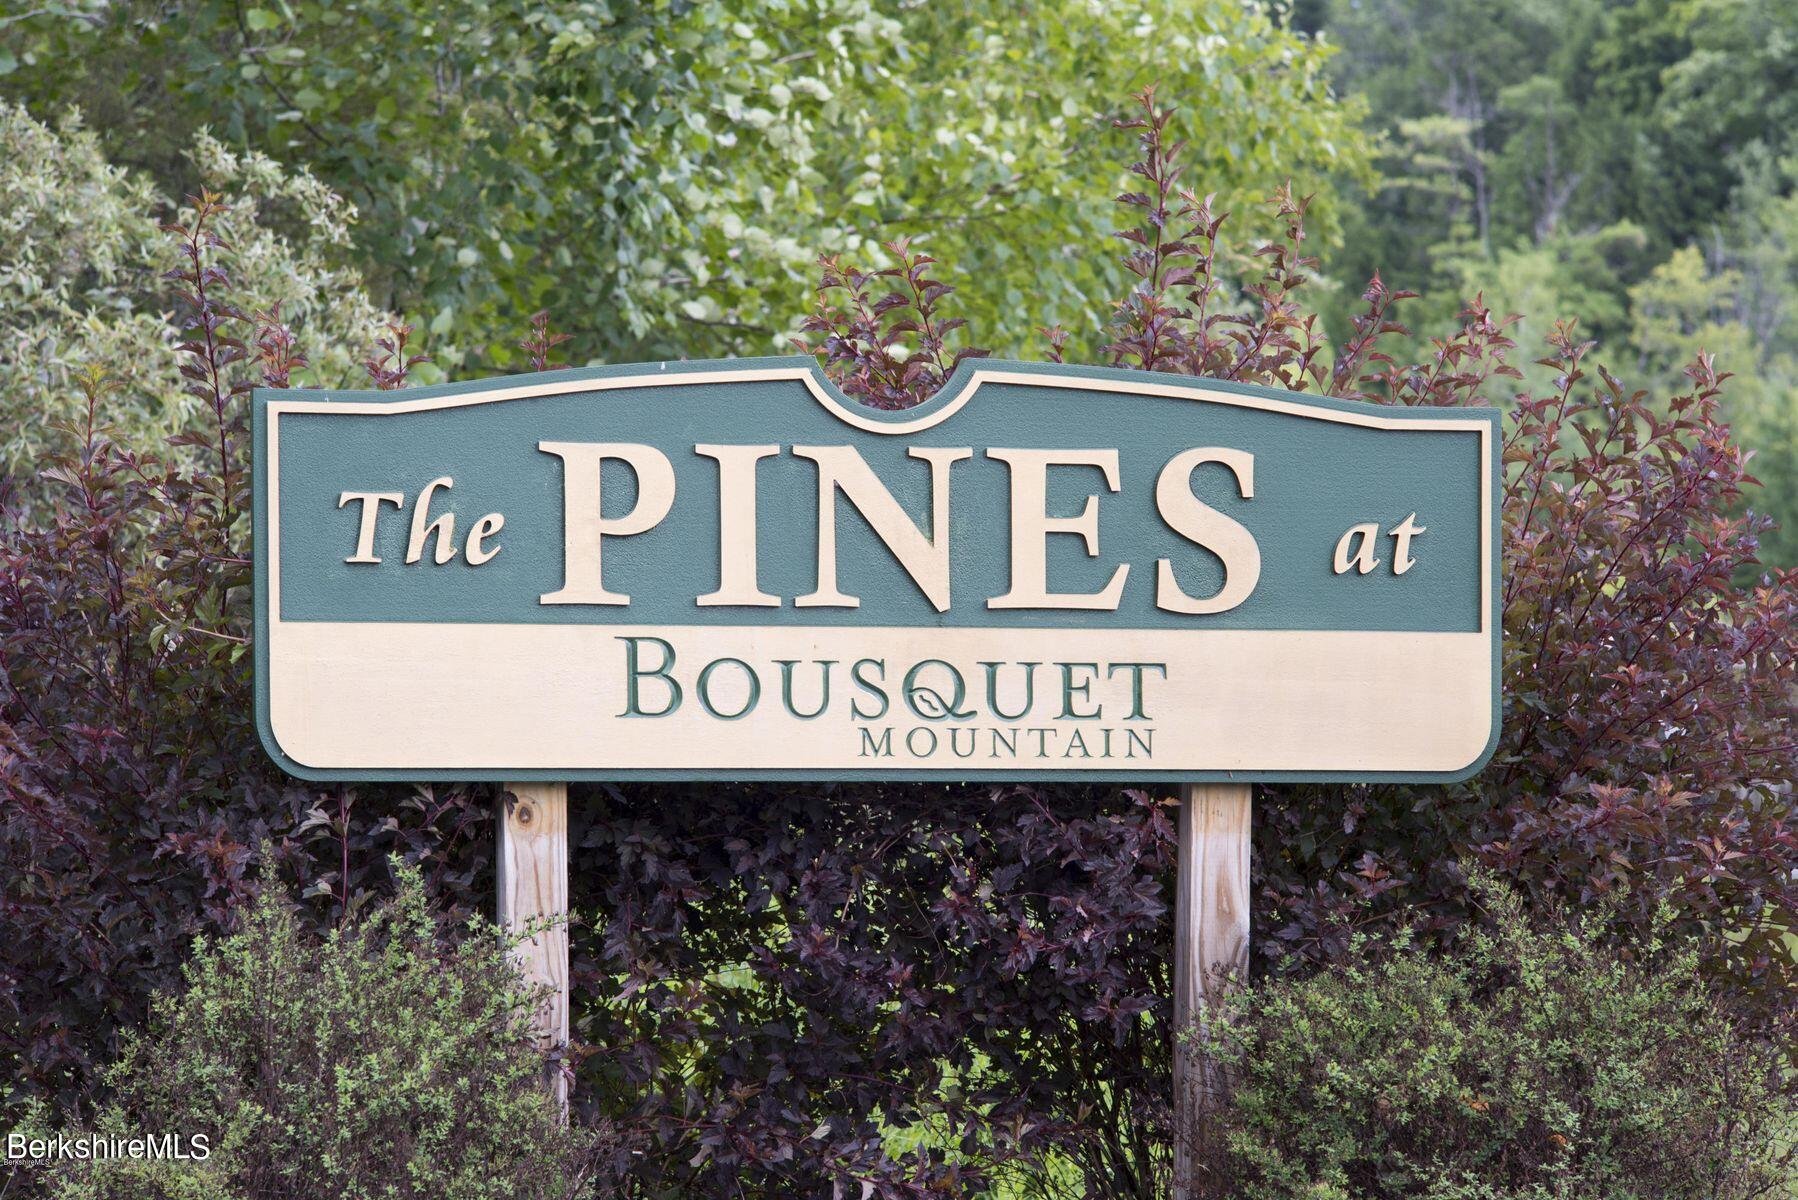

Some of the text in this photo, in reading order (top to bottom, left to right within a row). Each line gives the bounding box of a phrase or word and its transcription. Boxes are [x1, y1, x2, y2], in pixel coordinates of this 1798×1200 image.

[338, 441, 1427, 614] The PINES at
[614, 636, 1167, 722] BOUSQUET
[857, 726, 1156, 759] MOUNTAIN
